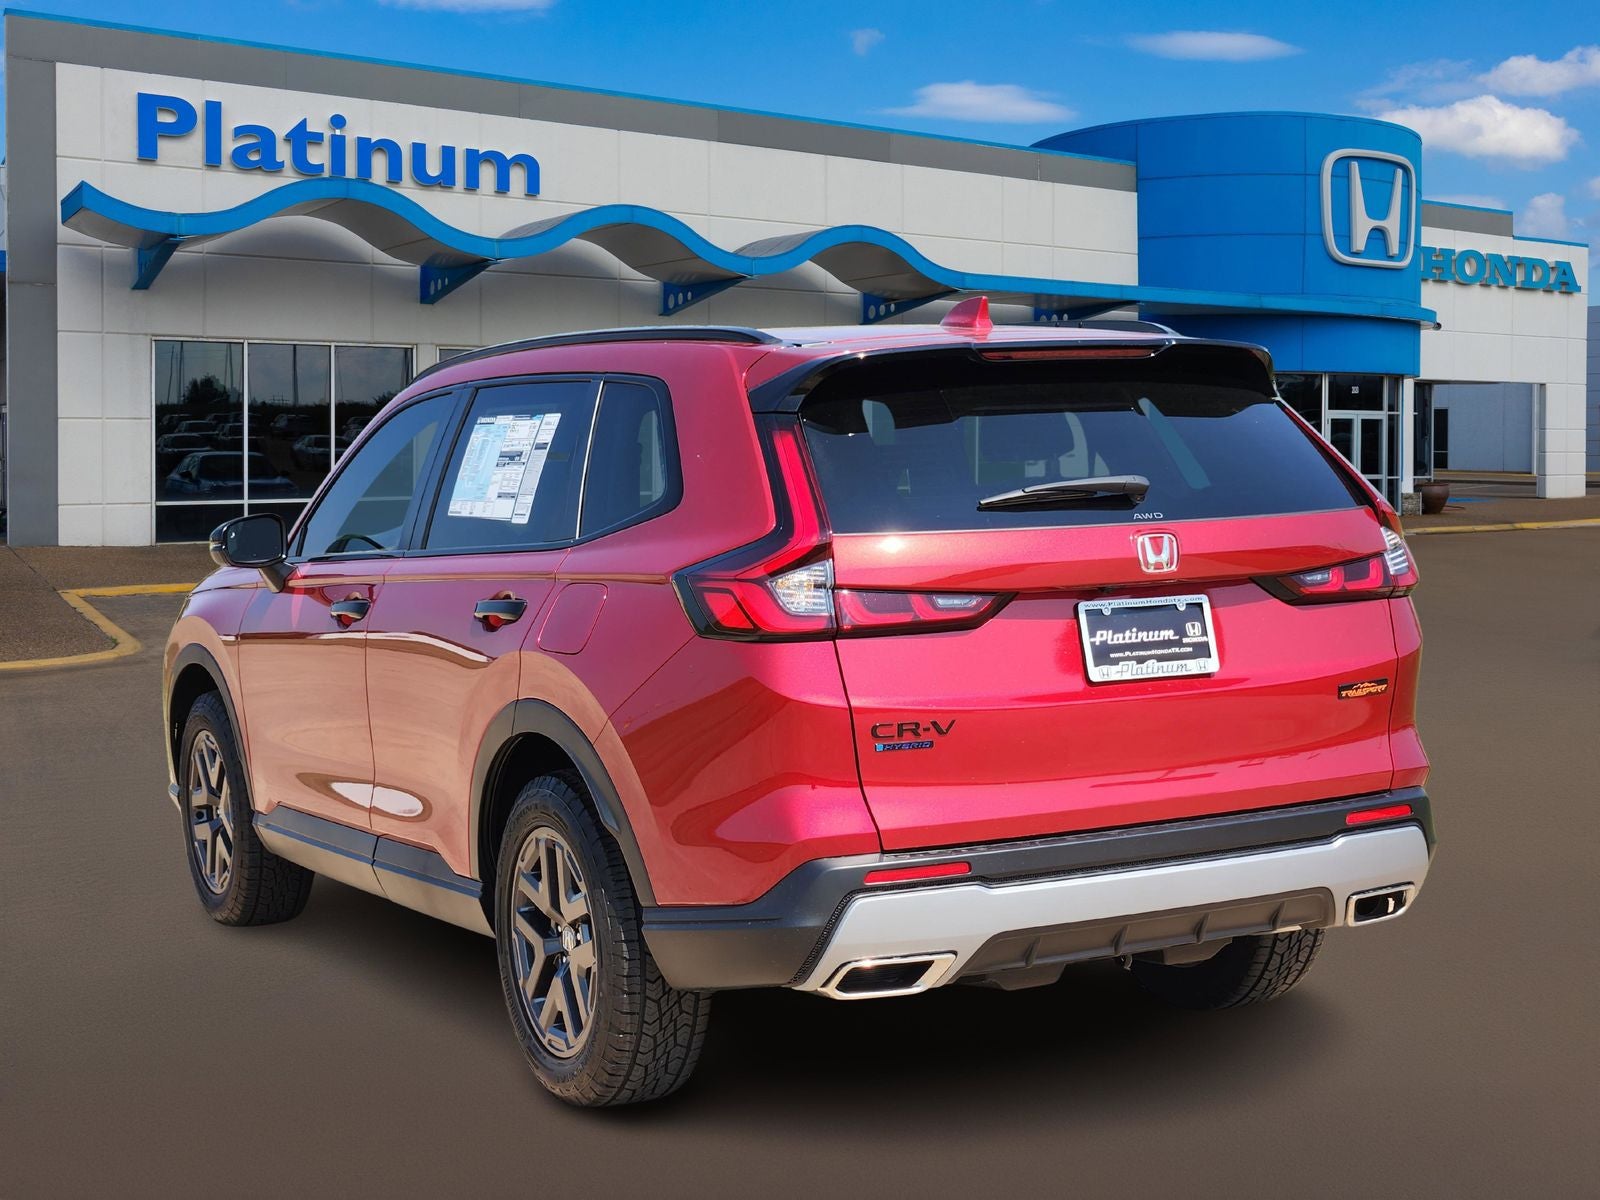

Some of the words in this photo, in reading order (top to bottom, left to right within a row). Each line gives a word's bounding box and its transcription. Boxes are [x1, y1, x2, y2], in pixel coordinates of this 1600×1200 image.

[137, 92, 541, 196] Platinum
[1421, 246, 1582, 294] HONDA
[1133, 512, 1164, 520] AWD
[1090, 627, 1179, 645] Platinum
[1115, 660, 1192, 677] Platinum
[870, 719, 956, 739] CR-V
[884, 741, 931, 751] HYBRID
